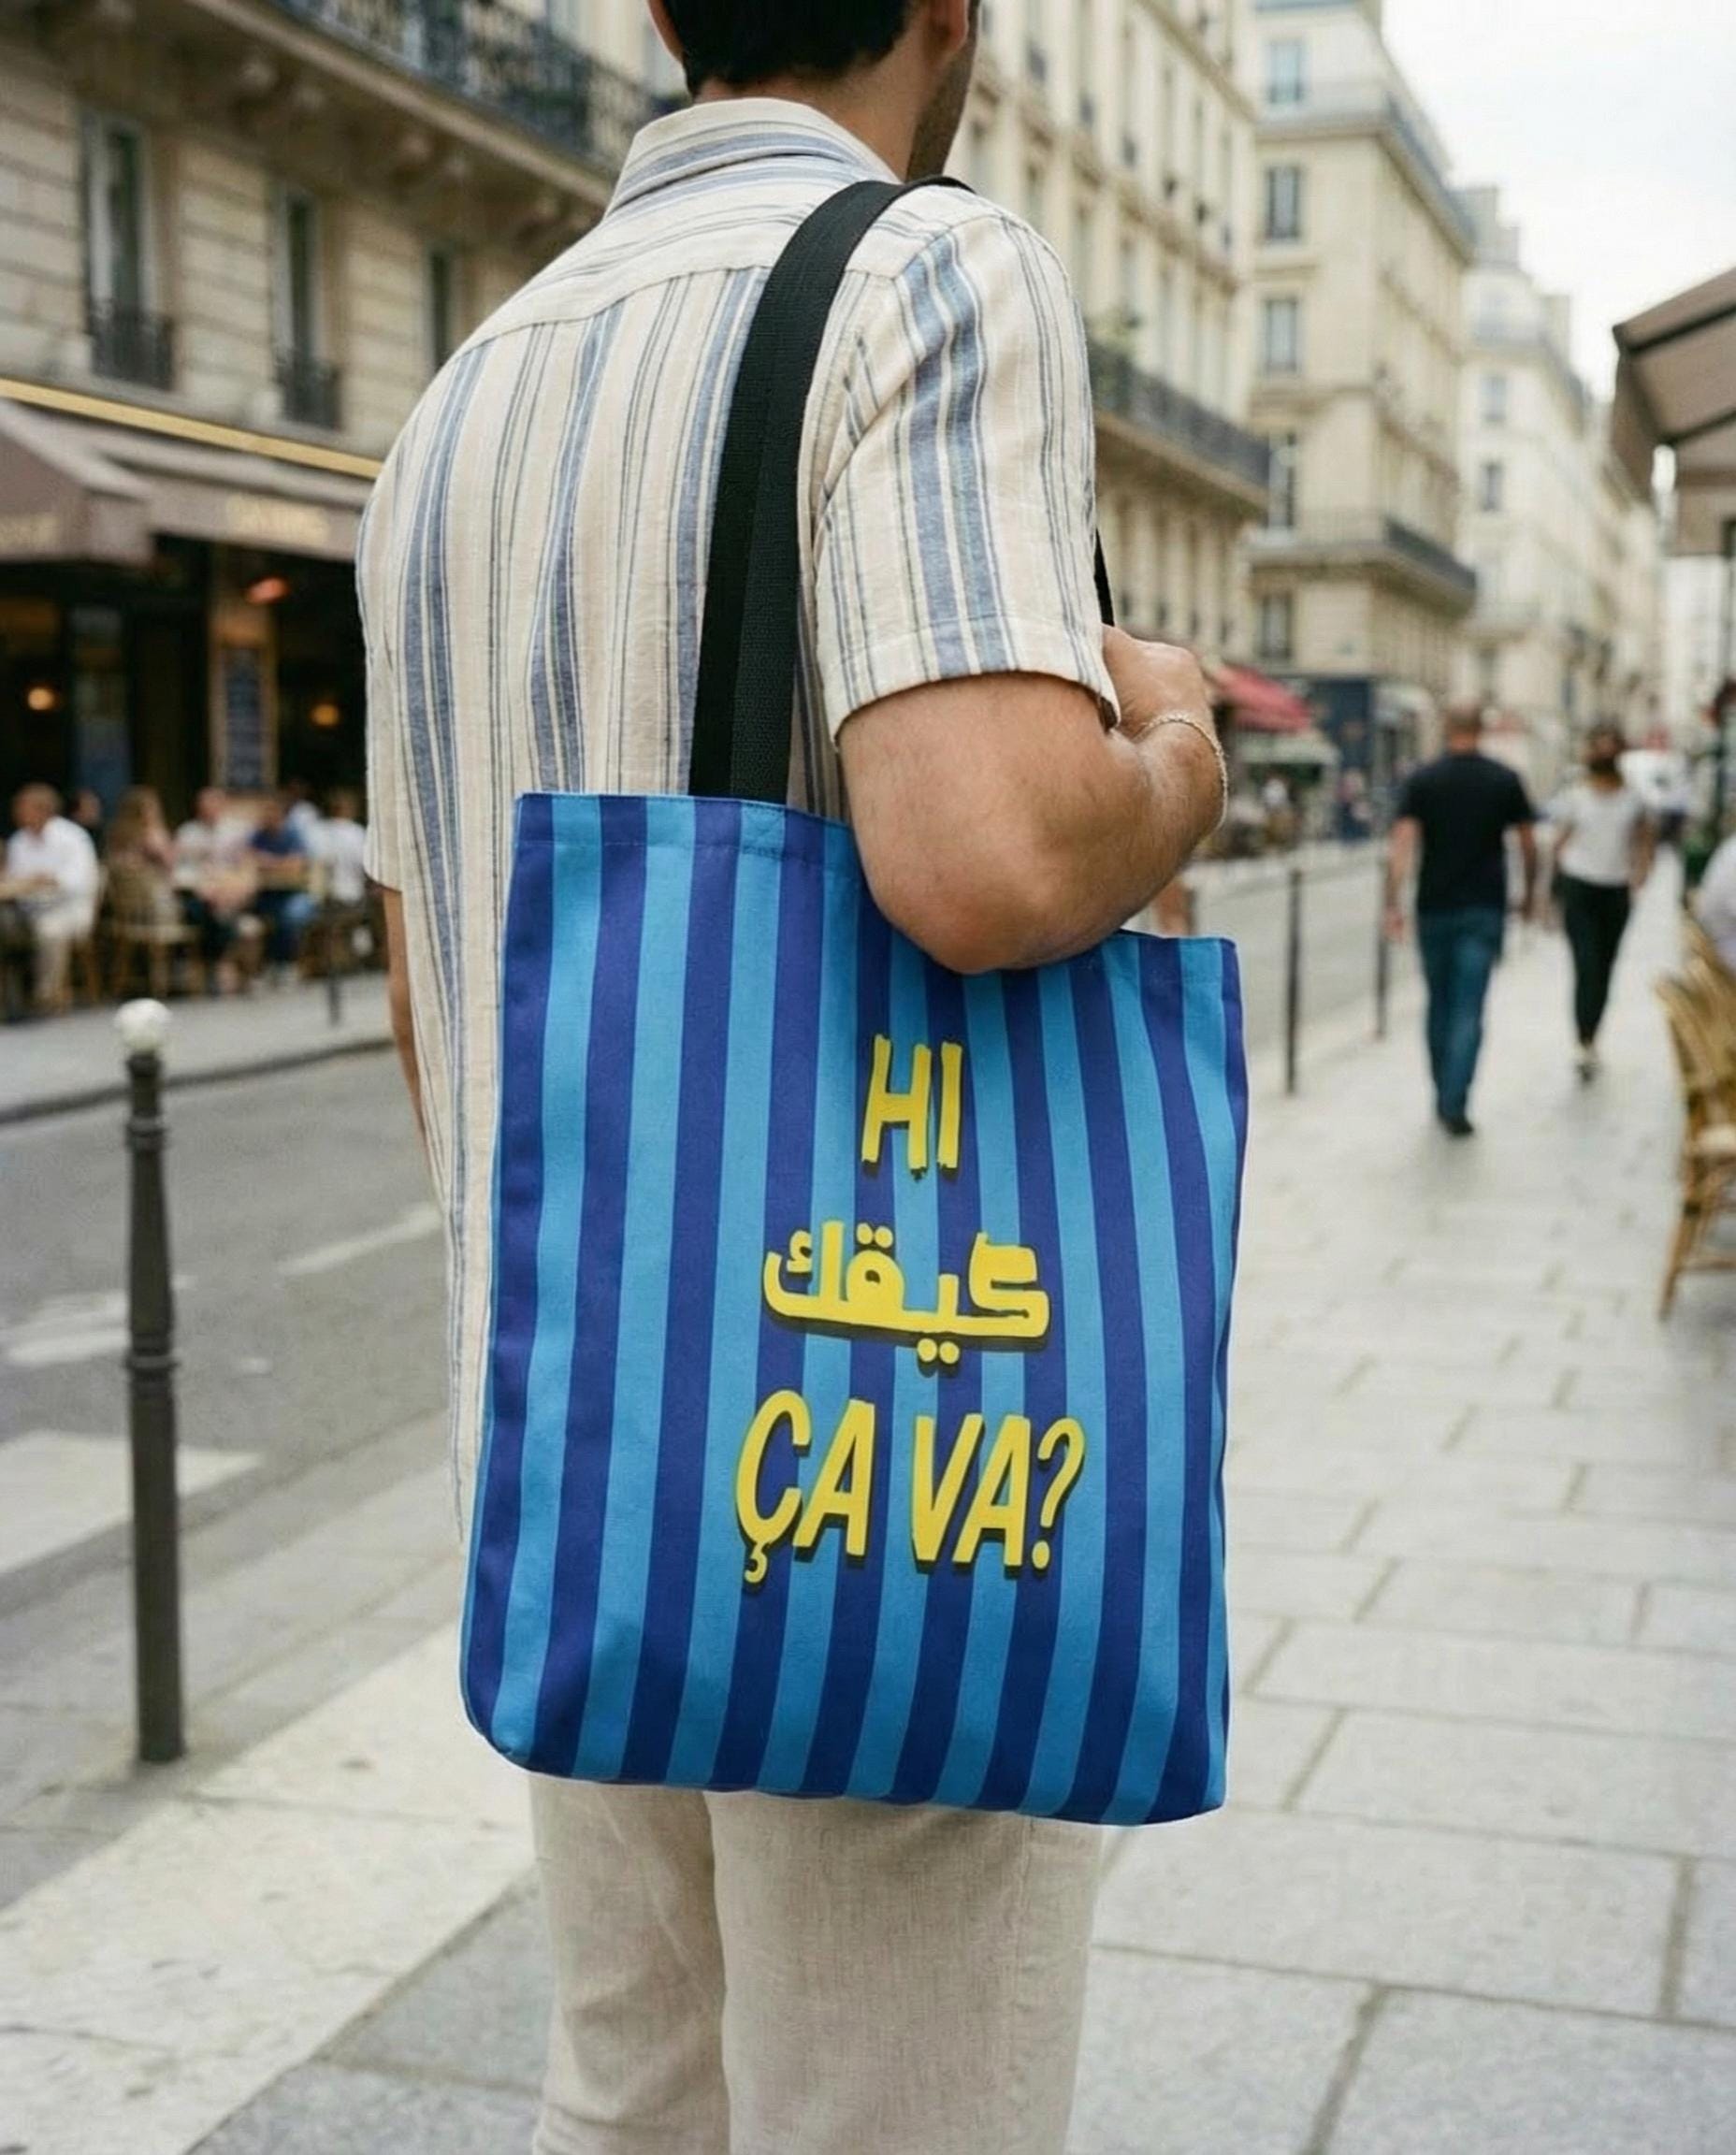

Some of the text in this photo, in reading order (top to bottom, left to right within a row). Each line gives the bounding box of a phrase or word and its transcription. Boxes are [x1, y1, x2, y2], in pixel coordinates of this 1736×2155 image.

[861, 1034, 962, 1173] HI
[734, 1389, 1086, 1583] ÇA VA?
